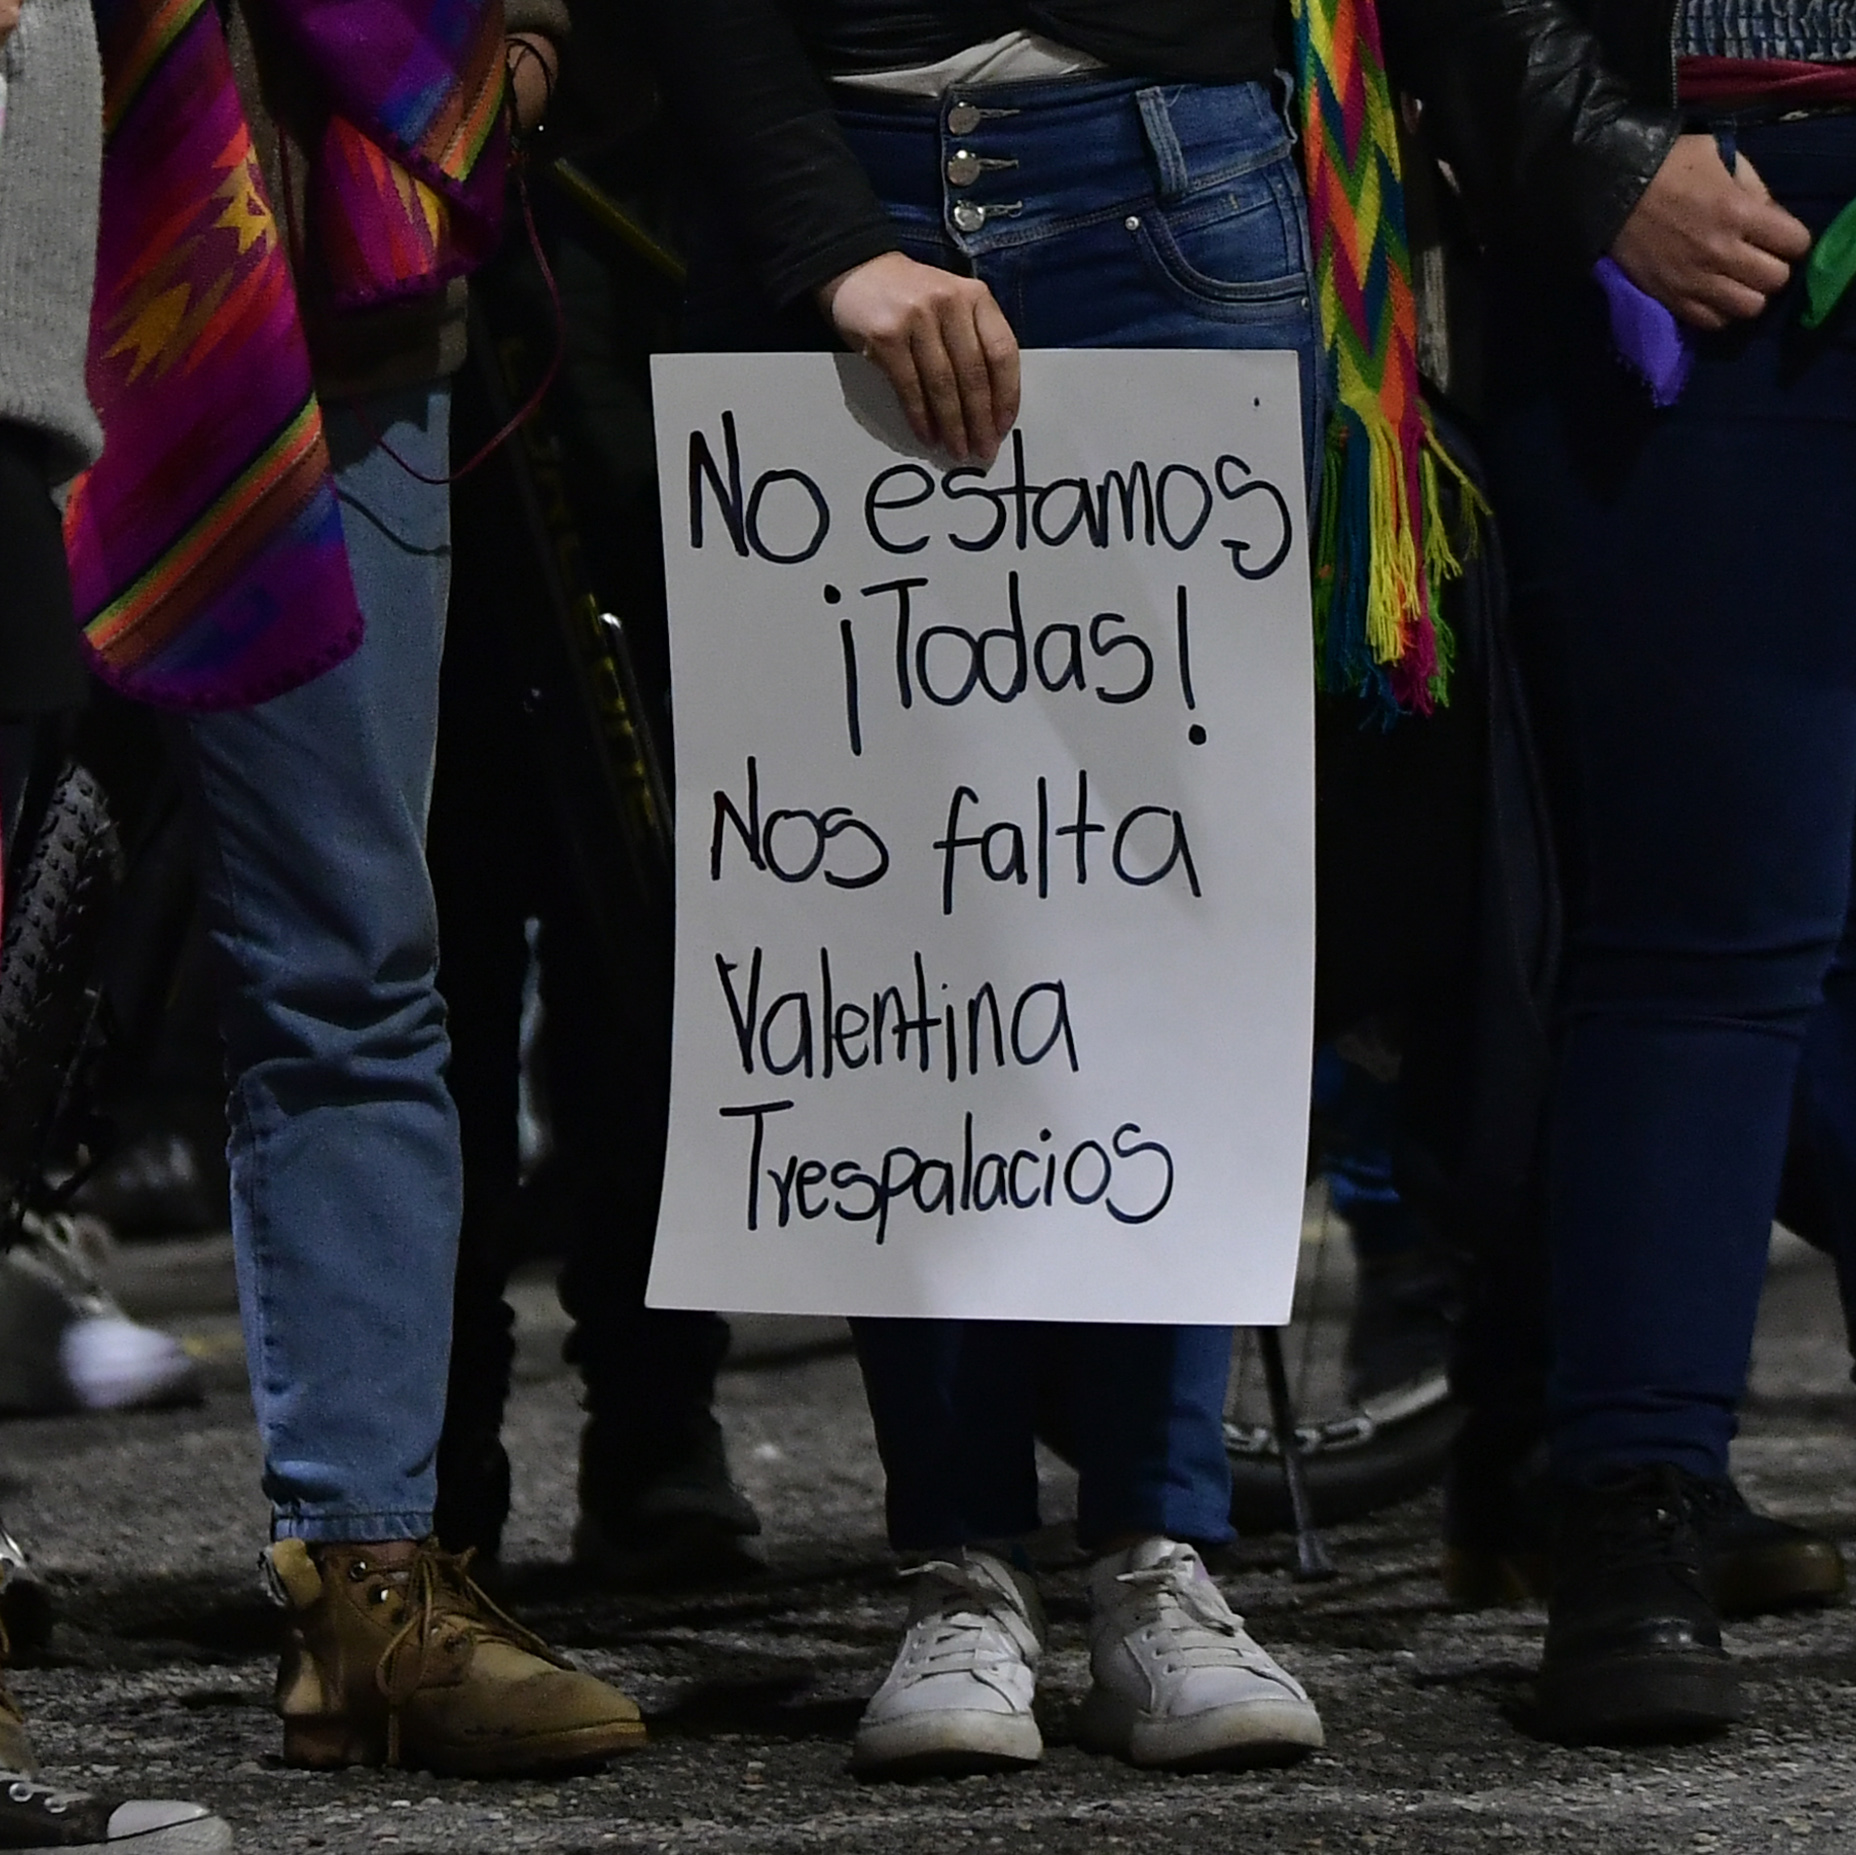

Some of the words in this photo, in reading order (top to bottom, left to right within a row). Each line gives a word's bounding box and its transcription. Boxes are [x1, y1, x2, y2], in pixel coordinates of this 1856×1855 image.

[689, 411, 831, 564] No
[864, 427, 1293, 580] estamos
[823, 570, 1208, 756] ¡Todas!
[710, 755, 890, 890] Nos
[932, 769, 1203, 916] falta
[714, 946, 1079, 1082] Valentina
[718, 1099, 1175, 1246] Trespalacios
